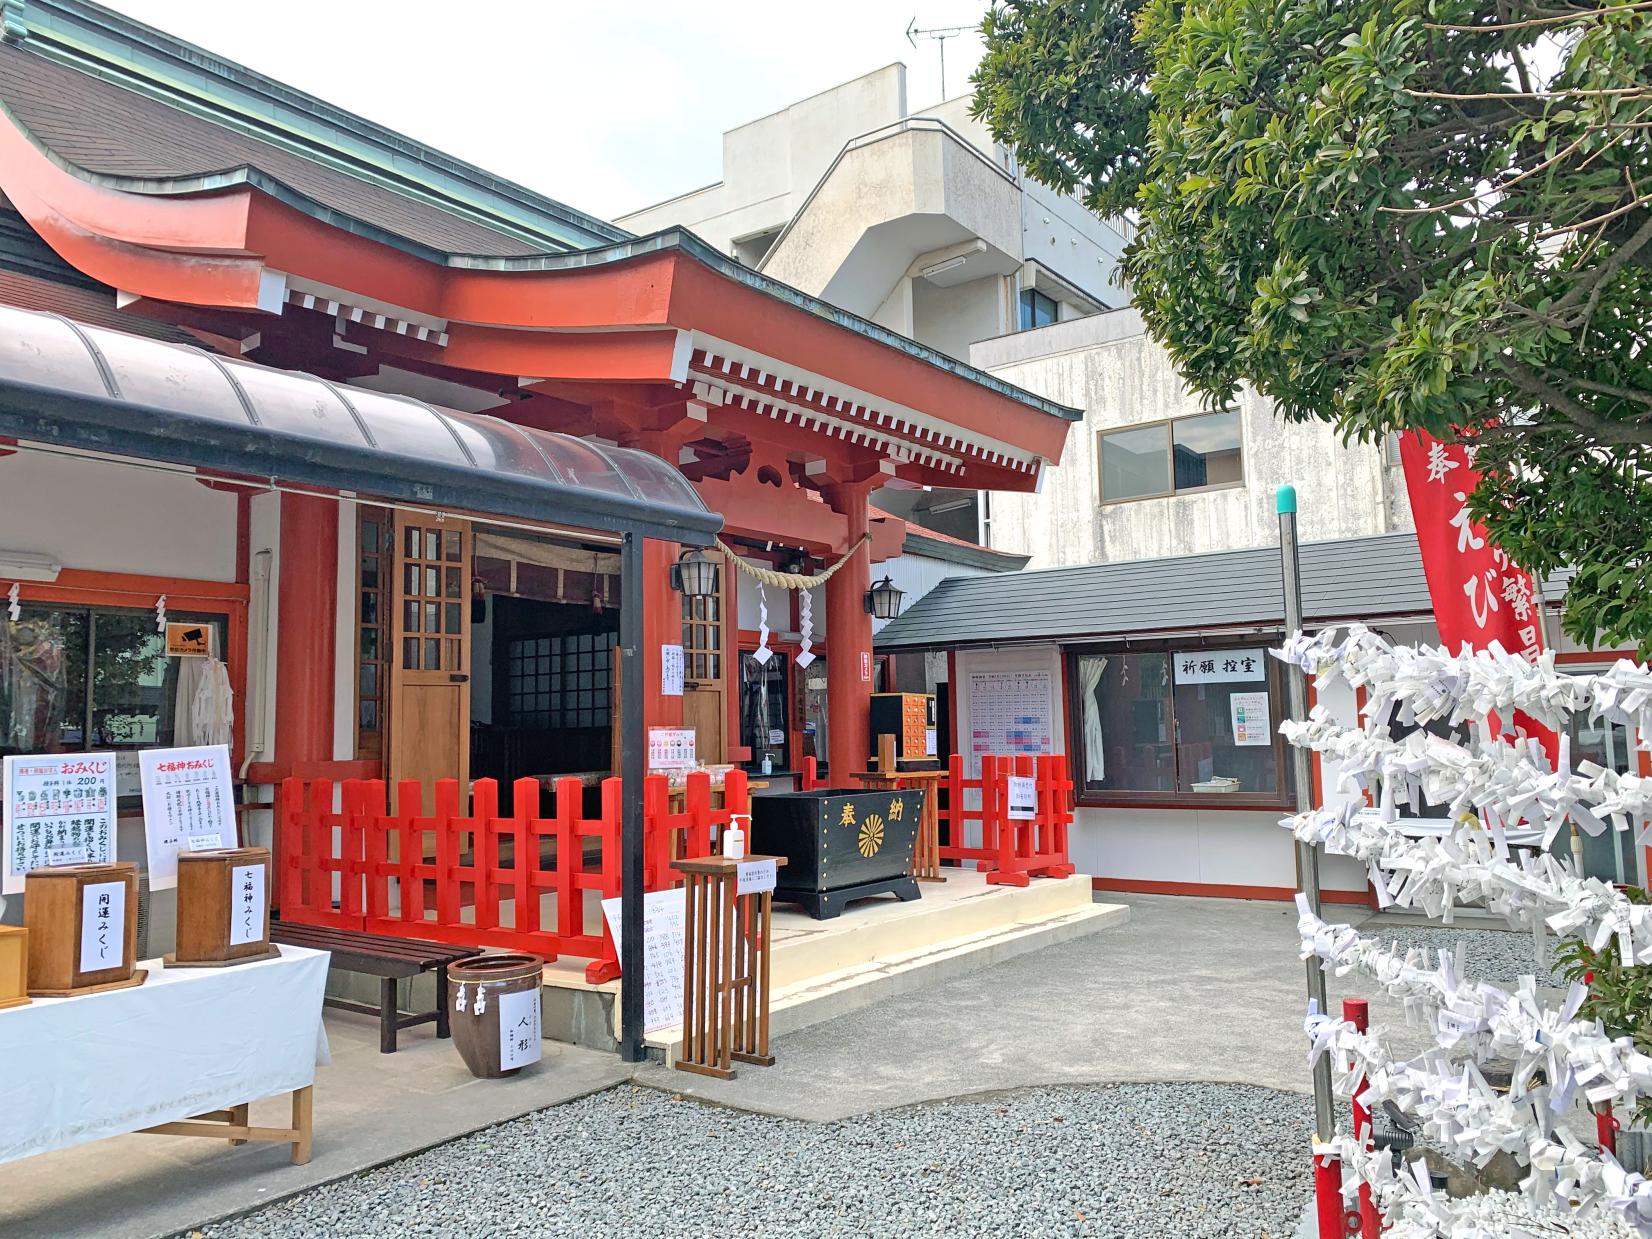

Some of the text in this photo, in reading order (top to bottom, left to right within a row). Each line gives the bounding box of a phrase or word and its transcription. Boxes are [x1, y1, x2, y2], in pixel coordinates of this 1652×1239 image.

[1182, 656, 1256, 675] 祈願 控室
[61, 761, 107, 774] おみくじ
[157, 758, 214, 772] 七福神おみくじ
[77, 776, 97, 785] 200
[839, 797, 904, 828] 奉 納
[243, 871, 254, 938] 七福神みくじ
[98, 893, 110, 959] 開運みくじ
[518, 1016, 529, 1051] 人形
